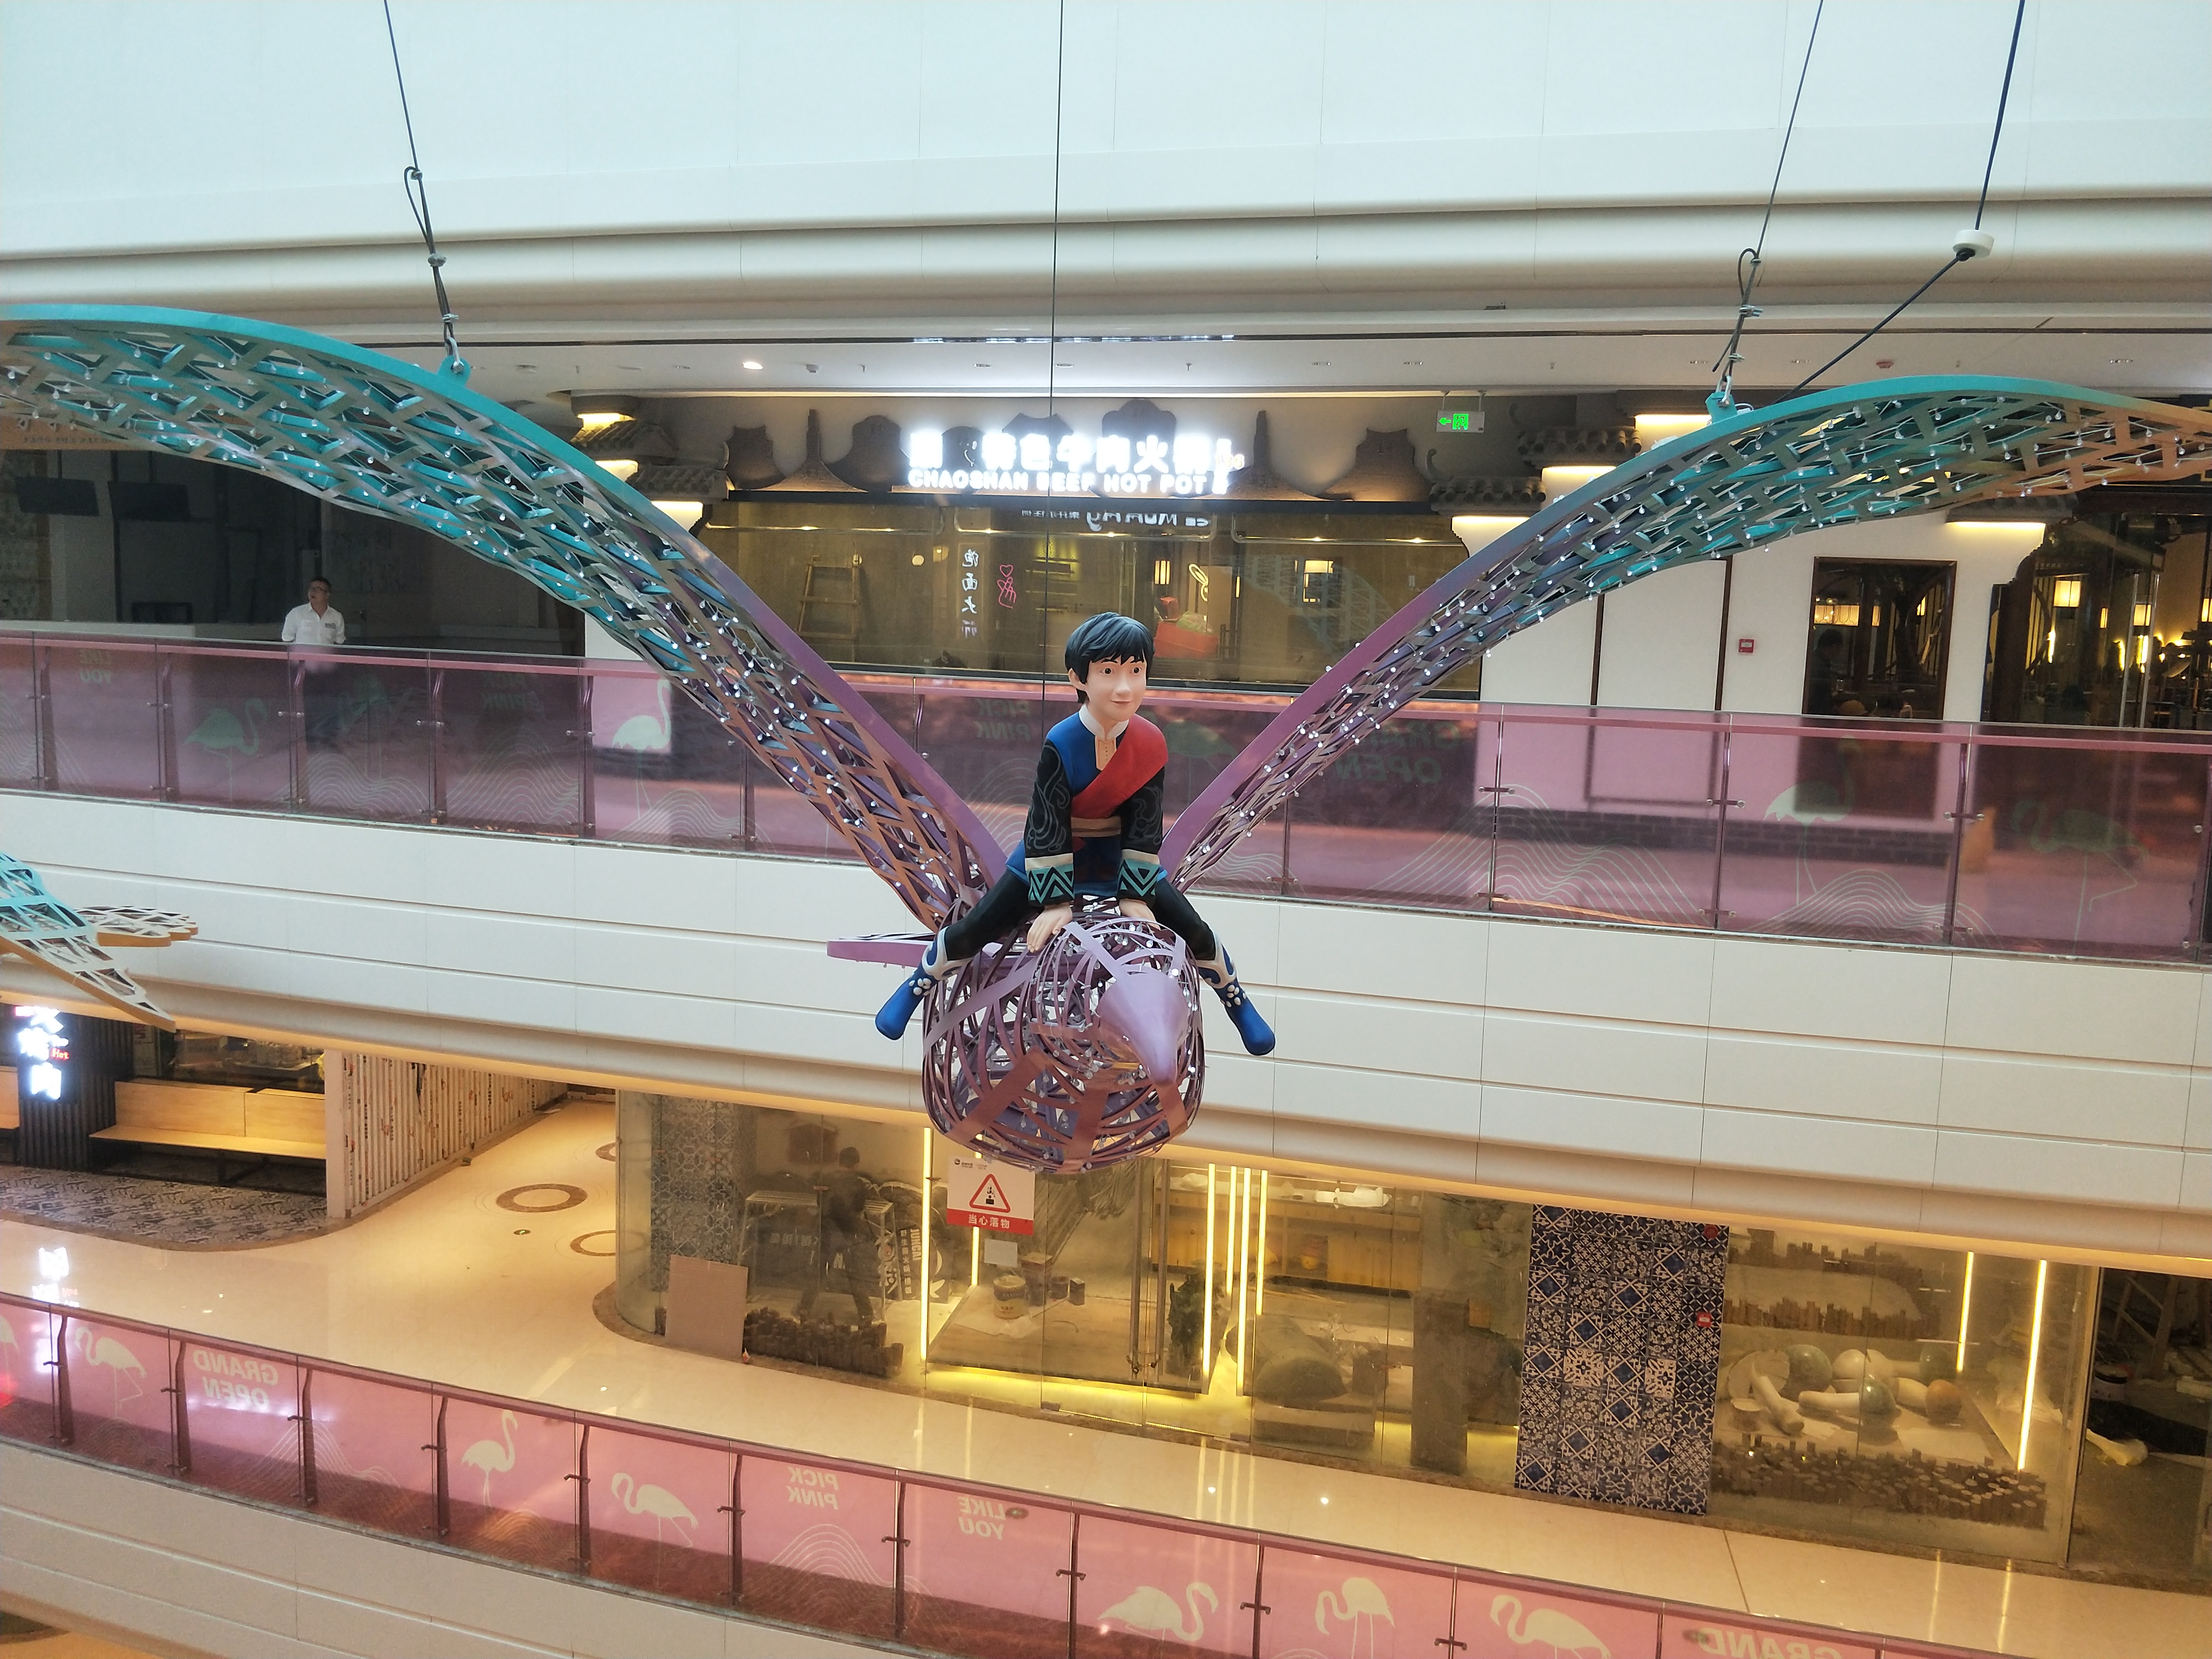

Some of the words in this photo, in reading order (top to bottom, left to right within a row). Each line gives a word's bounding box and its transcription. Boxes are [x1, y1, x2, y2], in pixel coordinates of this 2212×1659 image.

[909, 469, 1028, 491] CHAOSHAN
[1037, 472, 1095, 492] BEEF
[1104, 473, 1151, 493] HOT
[1160, 474, 1207, 494] POT
[968, 1214, 1010, 1229] 当心落物
